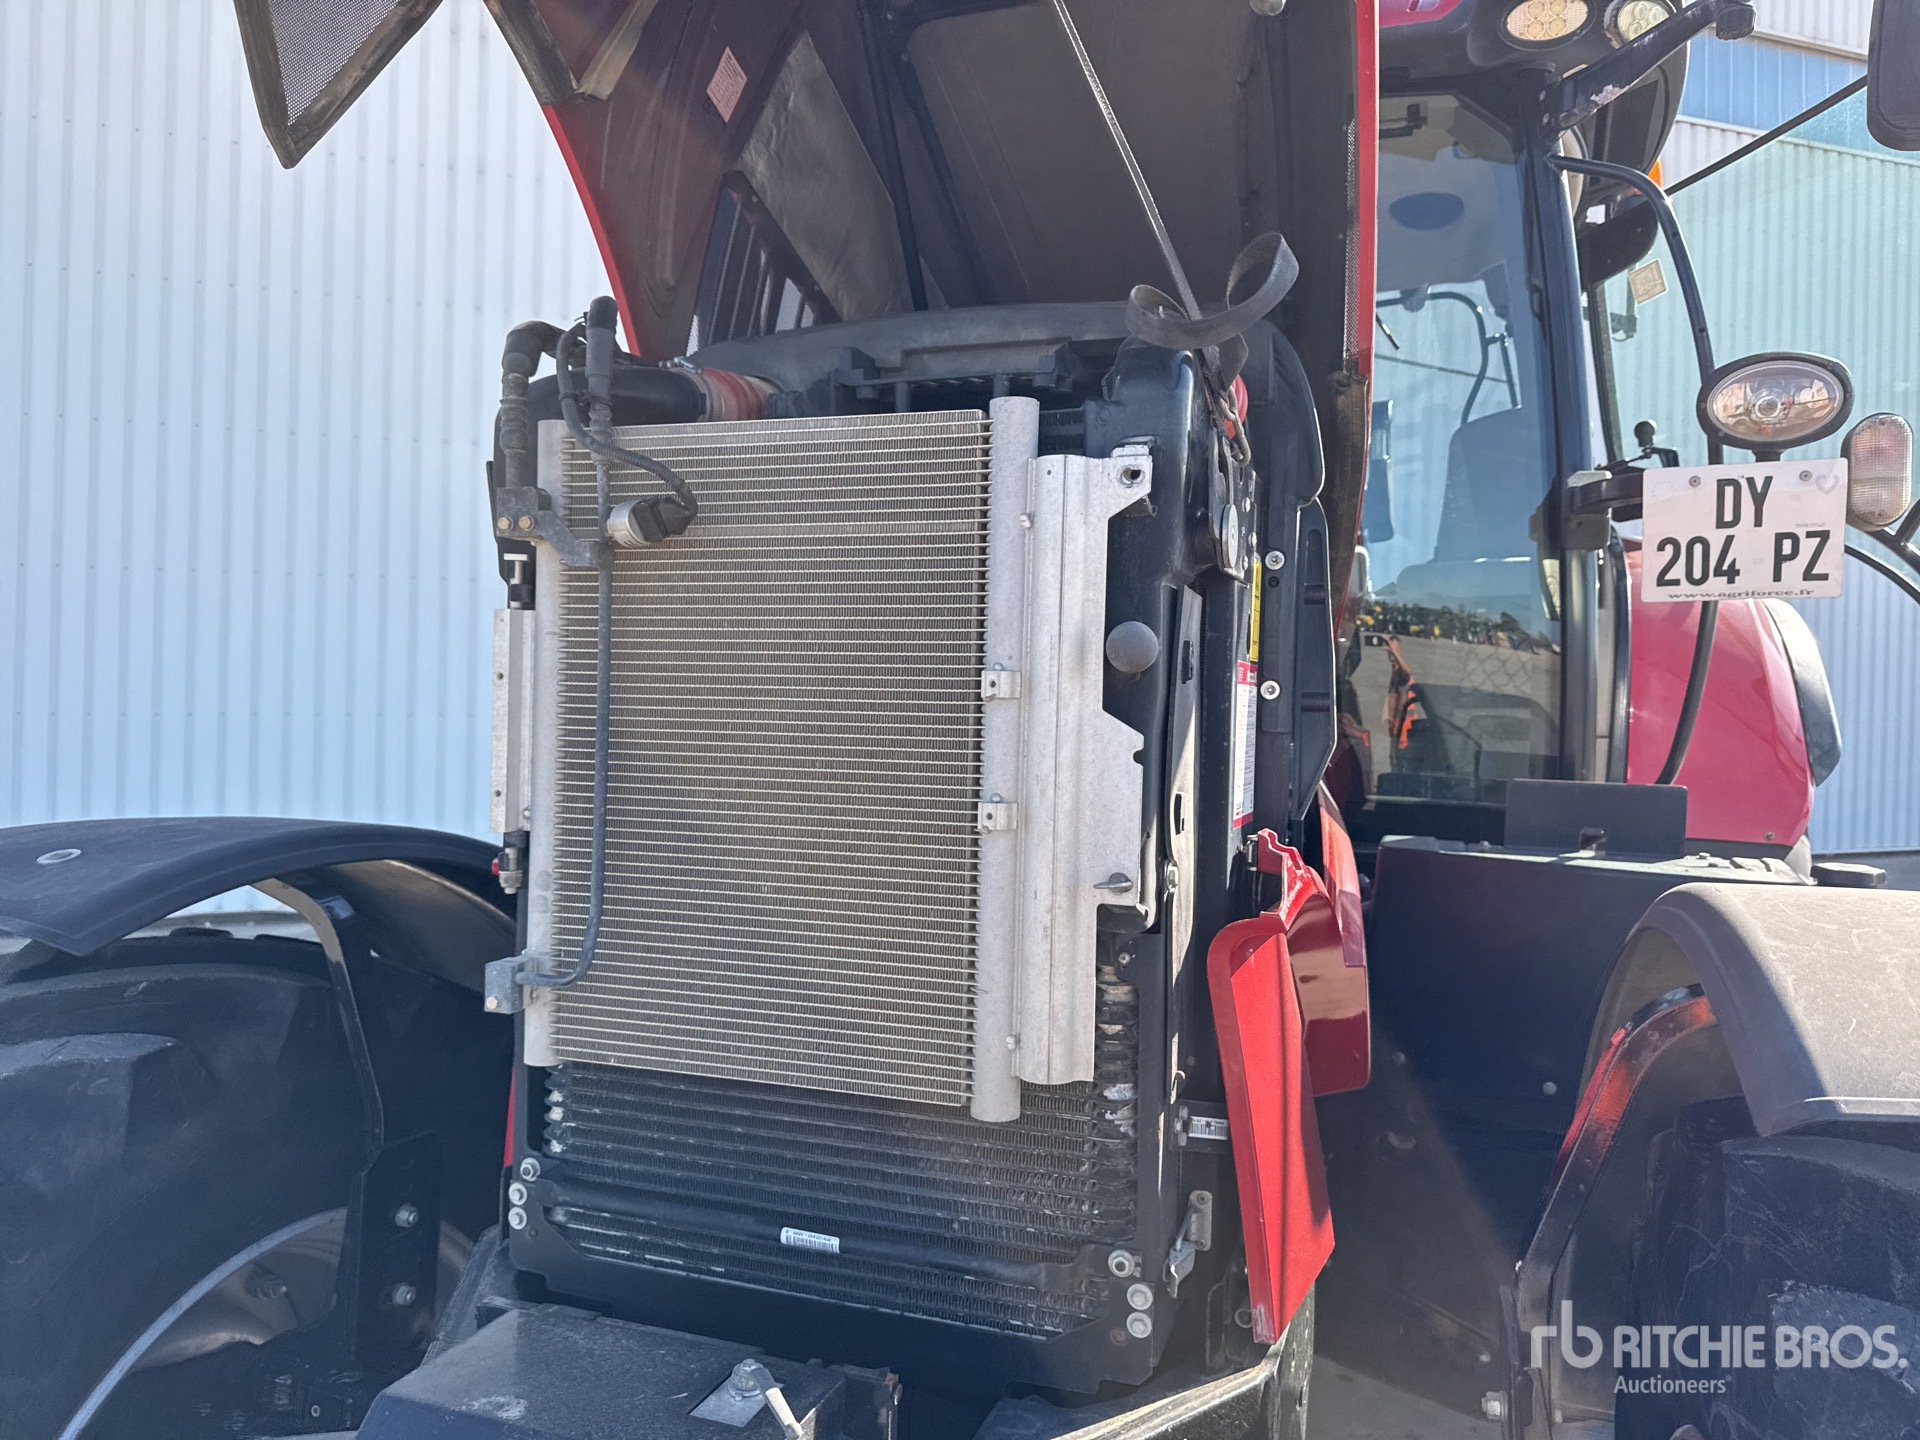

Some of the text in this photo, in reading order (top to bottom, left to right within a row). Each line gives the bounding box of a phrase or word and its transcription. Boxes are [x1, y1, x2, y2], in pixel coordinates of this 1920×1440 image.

[1715, 475, 1773, 529] DY
[1656, 530, 1831, 587] 204 PZ
[1668, 588, 1815, 599] www.agriforce.fr
